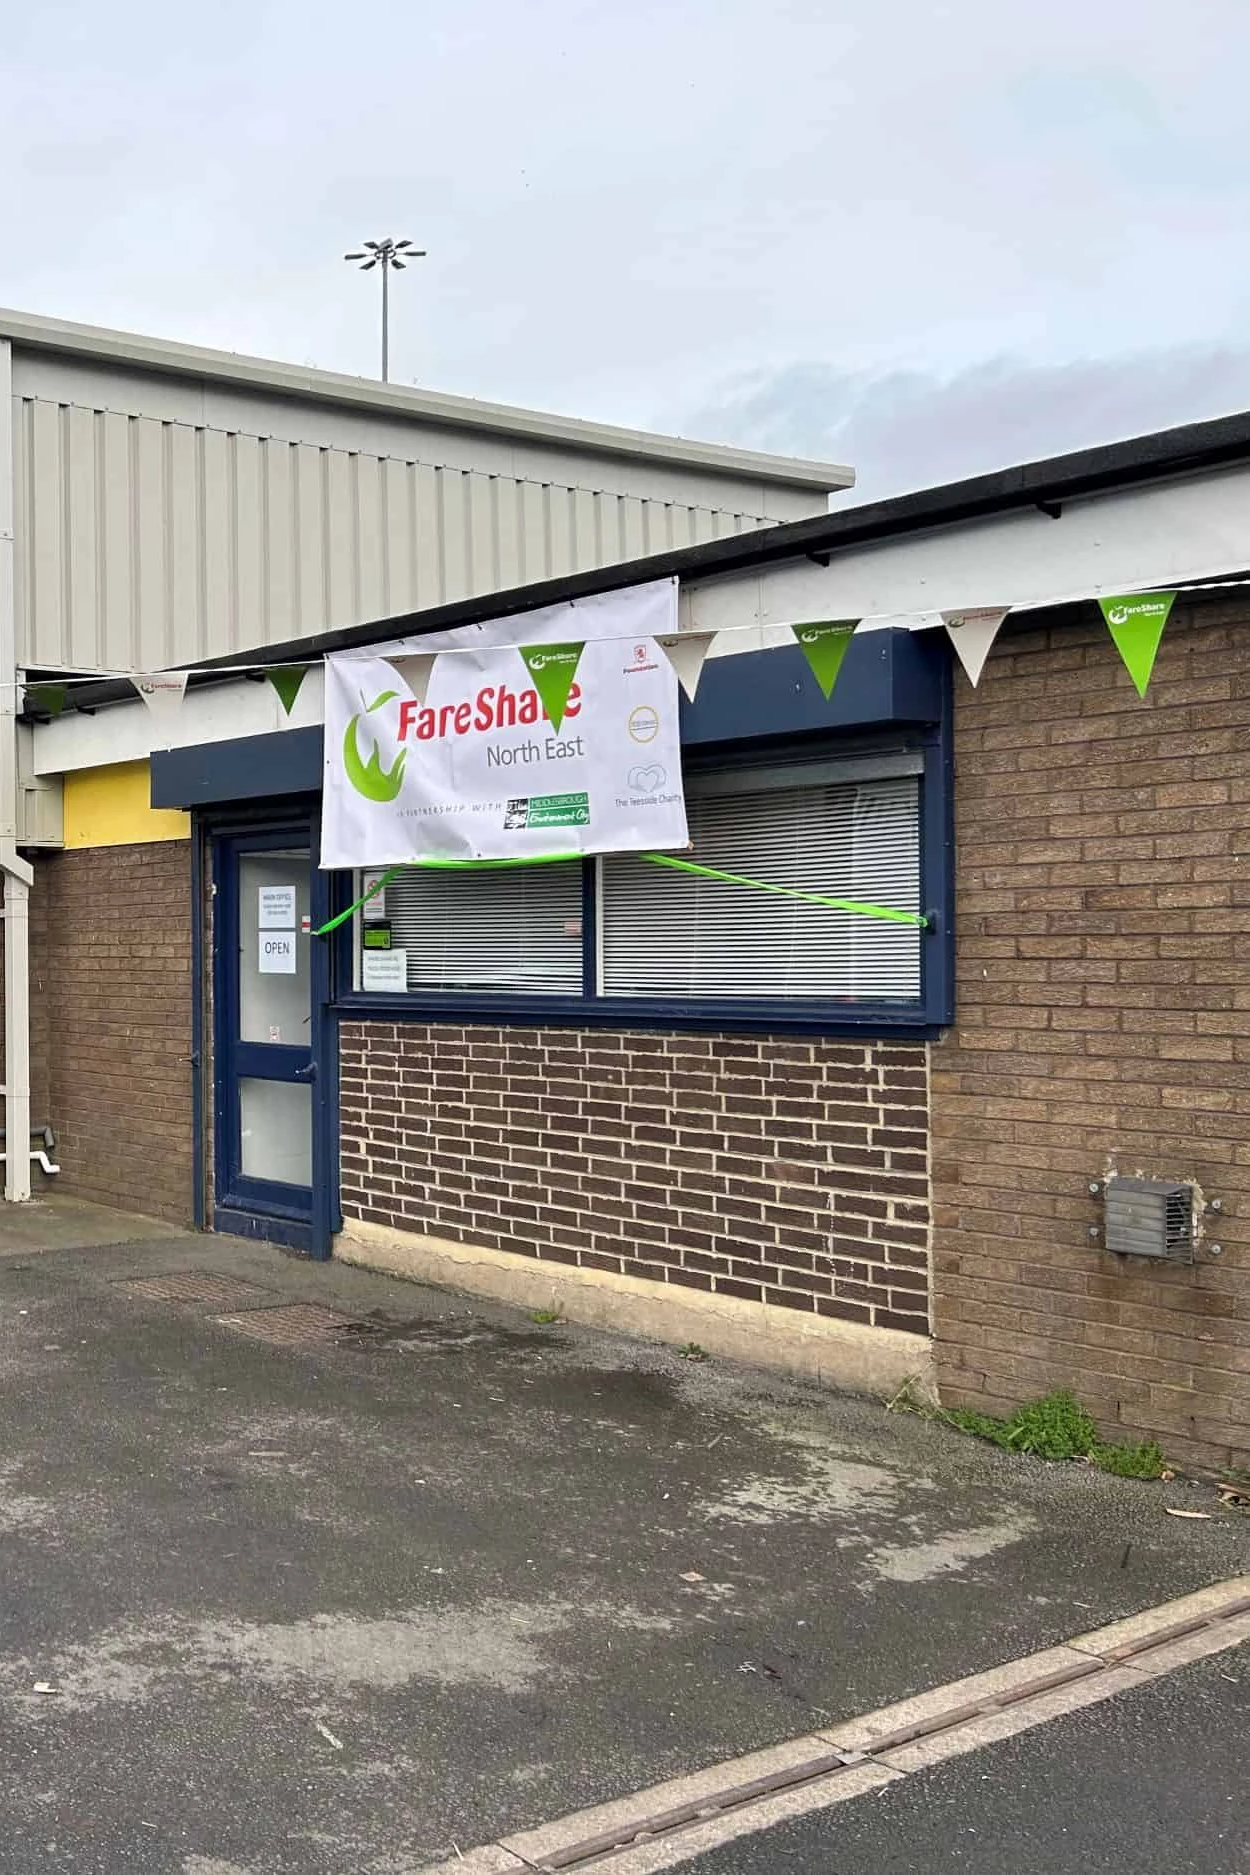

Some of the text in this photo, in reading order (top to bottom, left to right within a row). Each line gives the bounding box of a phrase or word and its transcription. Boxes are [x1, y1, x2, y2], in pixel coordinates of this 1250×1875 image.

[486, 735, 585, 768] North East
[472, 802, 502, 813] WITH
[265, 941, 289, 954] OPEN
